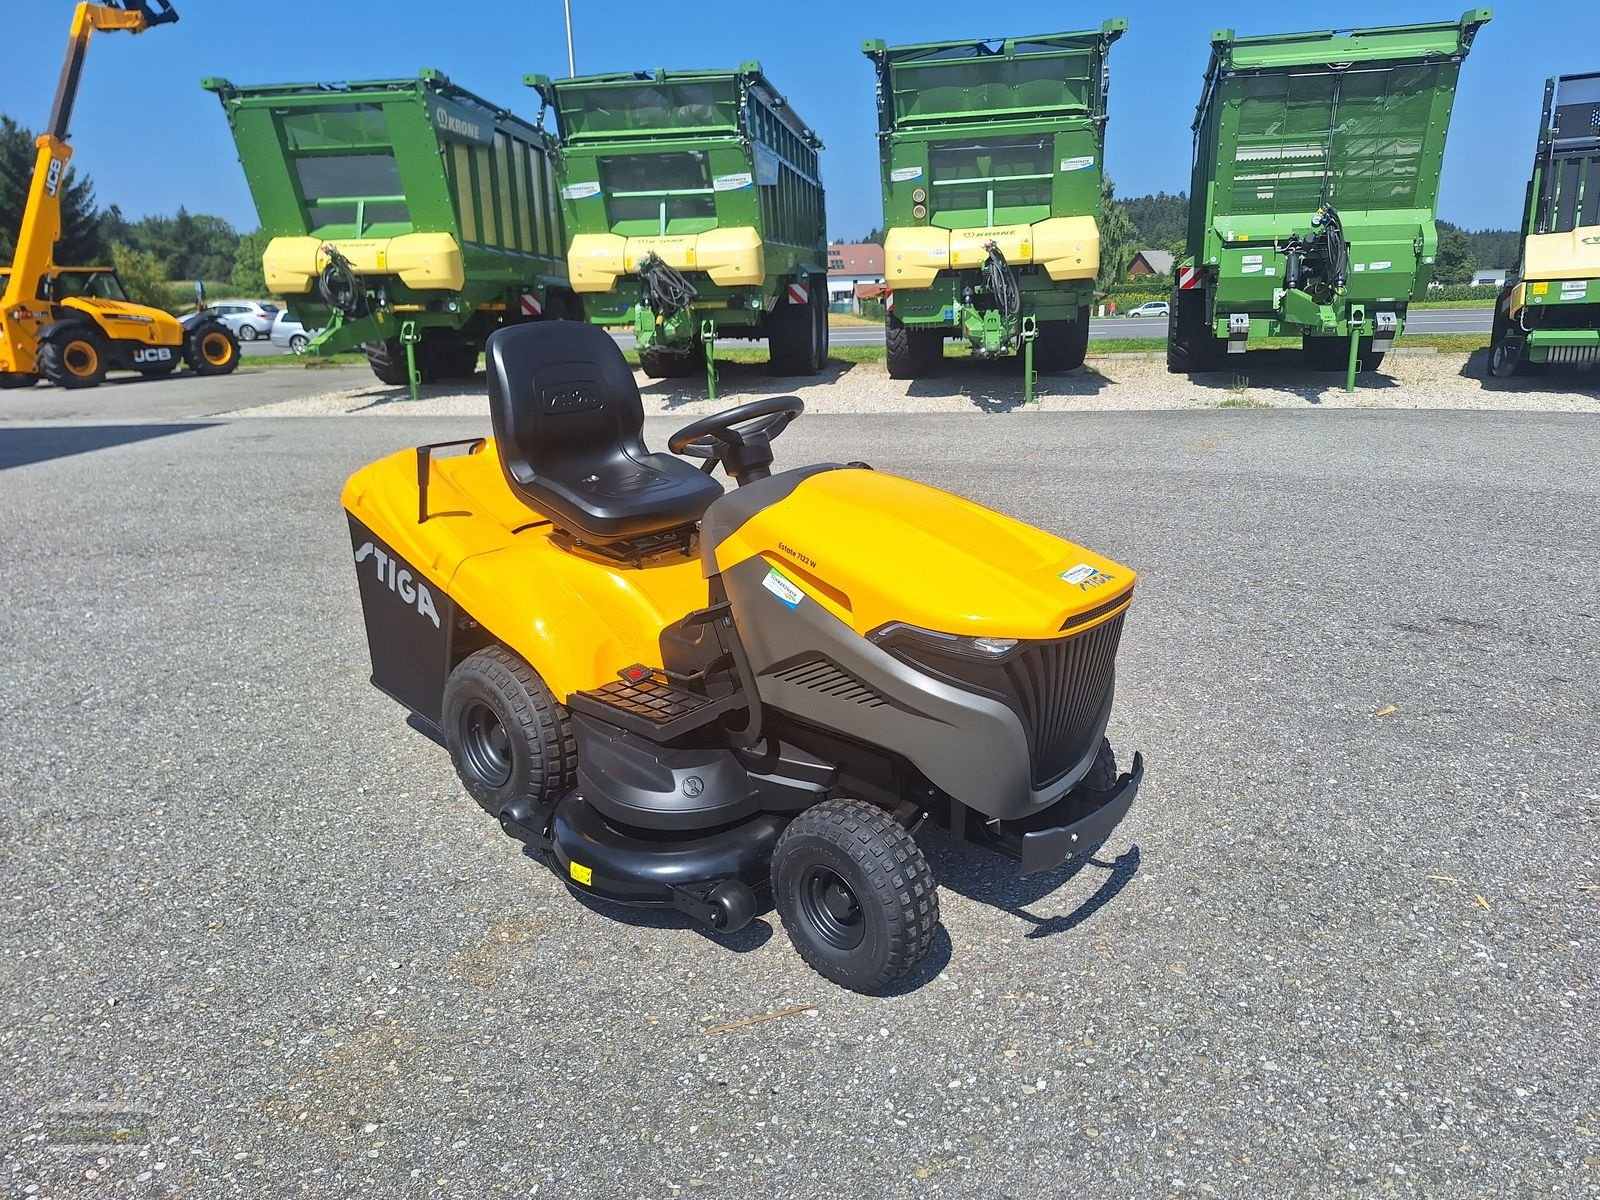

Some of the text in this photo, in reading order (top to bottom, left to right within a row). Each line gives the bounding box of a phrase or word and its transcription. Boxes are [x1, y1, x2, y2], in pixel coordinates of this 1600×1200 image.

[448, 115, 480, 140] KRONE
[45, 158, 62, 196] JCB
[976, 229, 1017, 237] KRONE
[133, 348, 172, 363] JCB
[778, 542, 817, 569] Estate 7122 W
[354, 541, 441, 630] STIGA
[1079, 573, 1116, 592] STIGA
